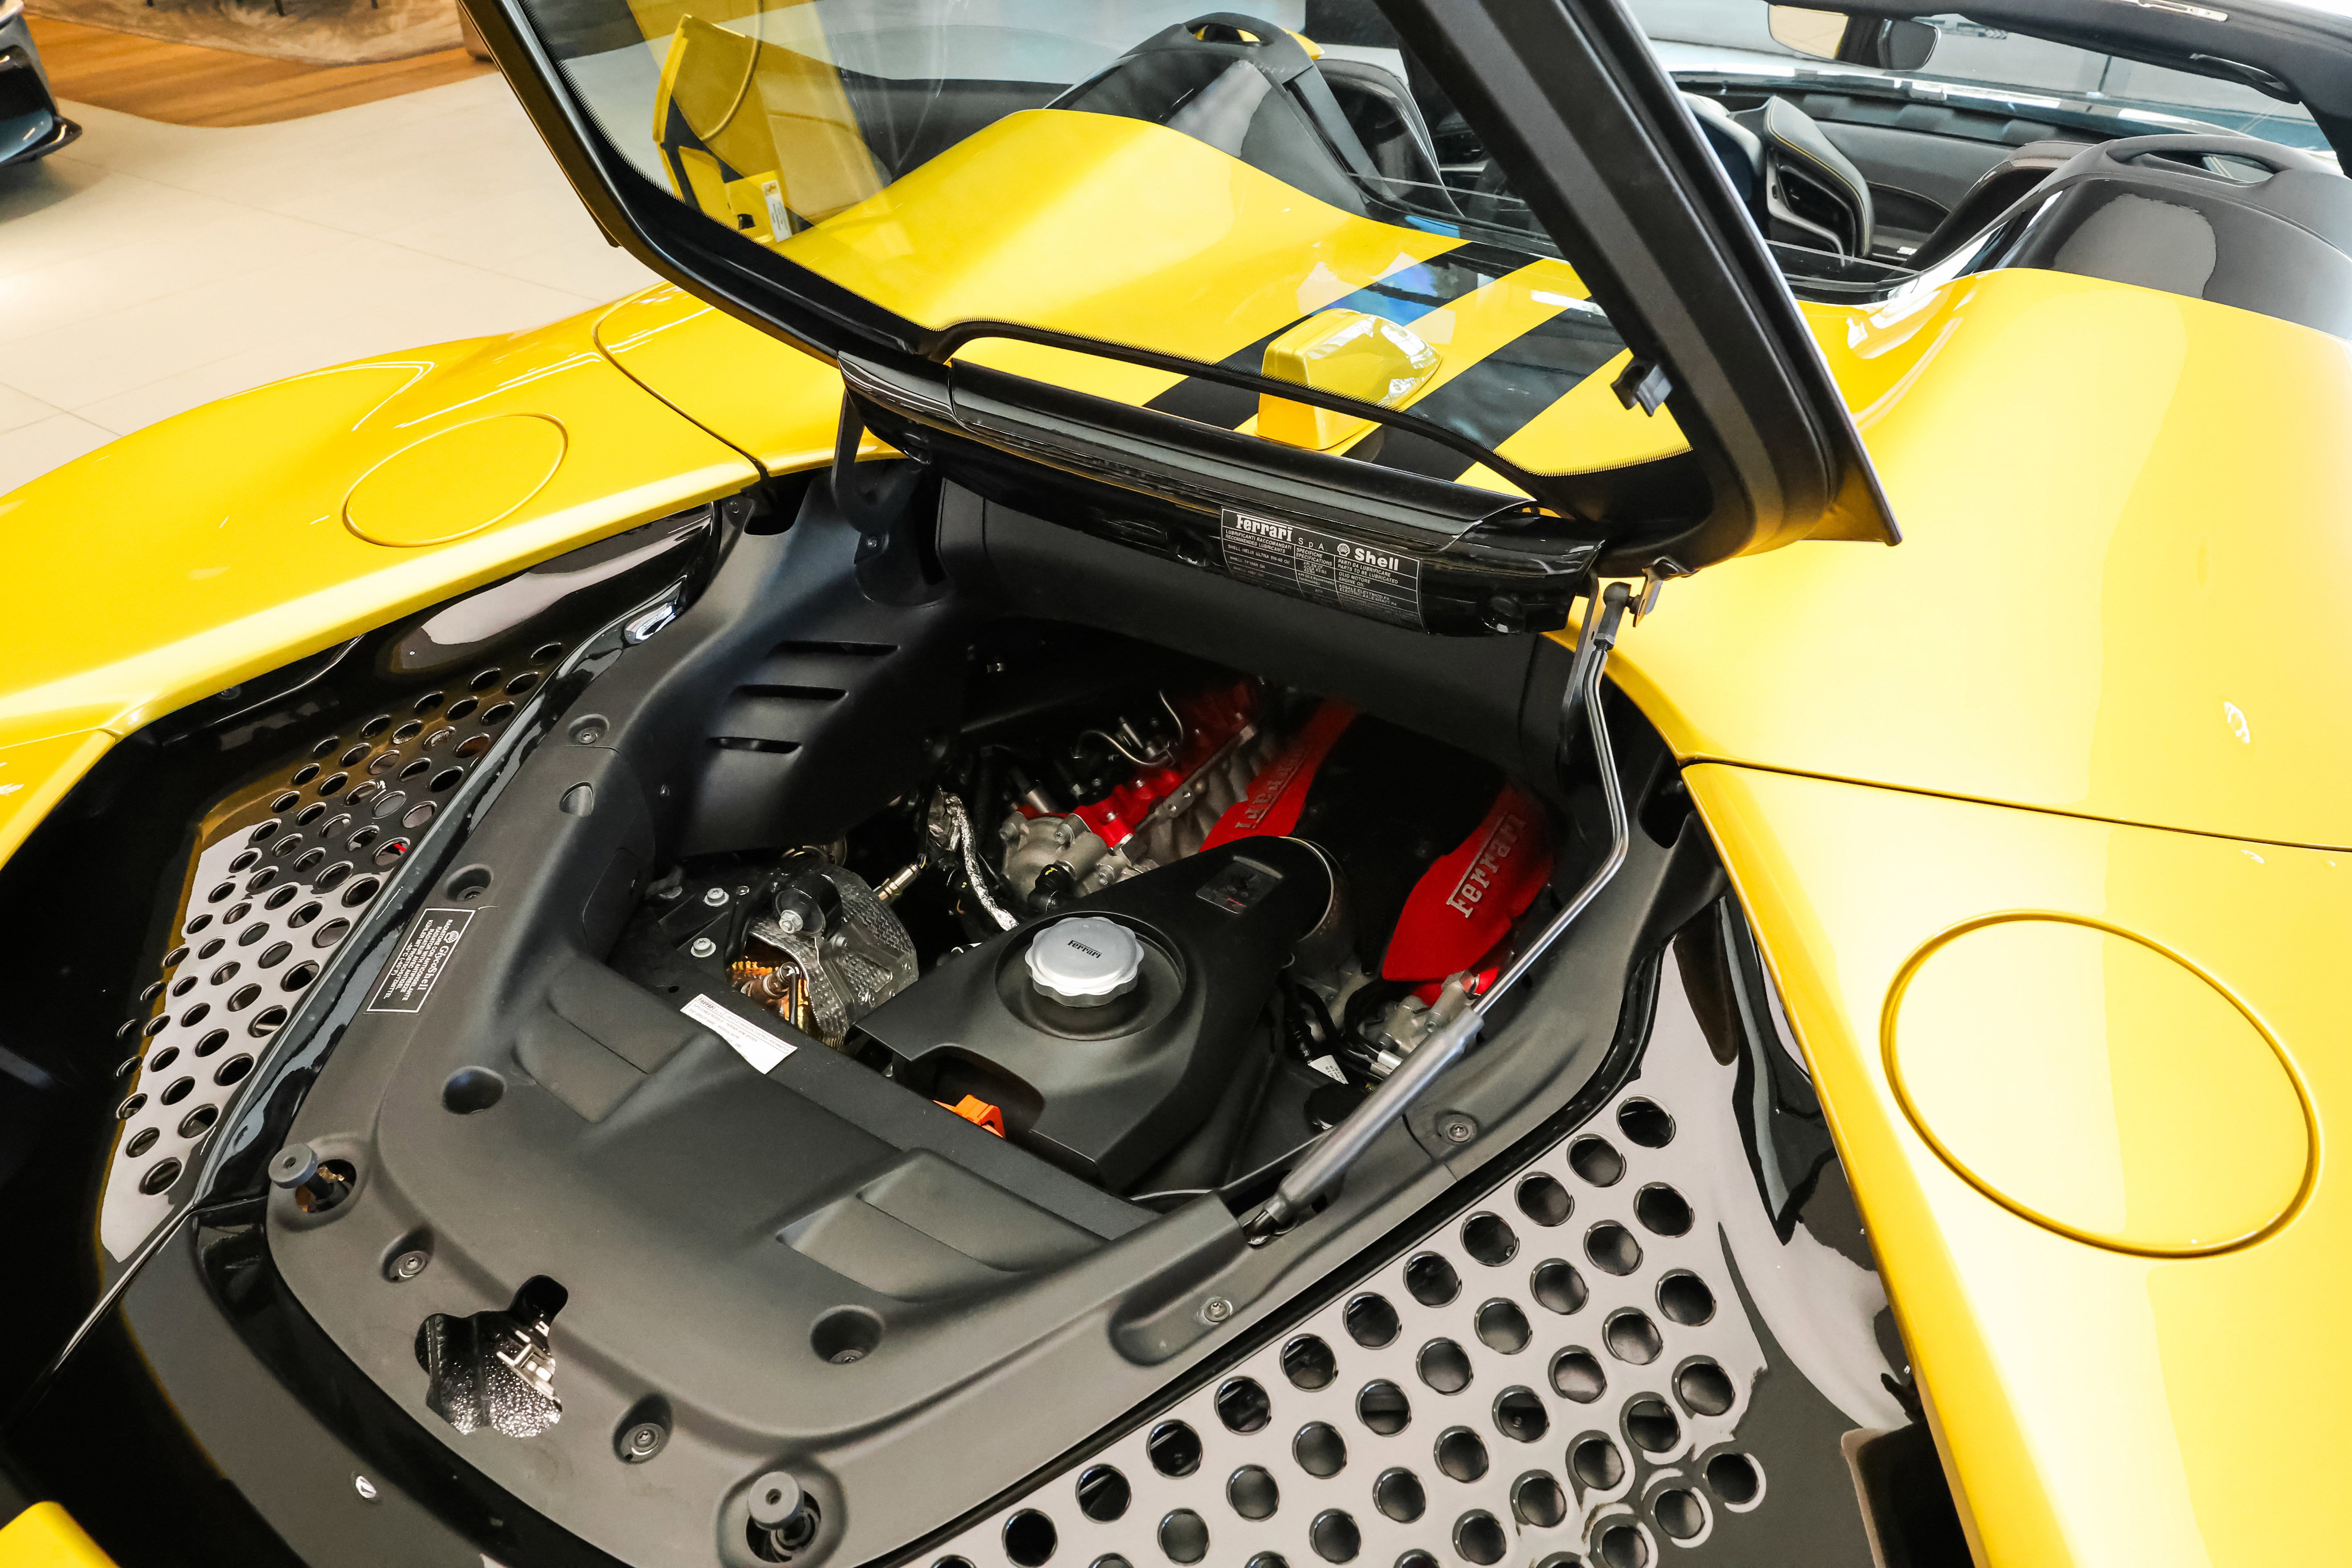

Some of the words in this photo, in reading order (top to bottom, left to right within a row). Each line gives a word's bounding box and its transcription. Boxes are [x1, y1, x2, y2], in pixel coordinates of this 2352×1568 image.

[1236, 514, 1293, 541] Ferrari
[1226, 529, 1255, 540] LUBRIFICANTI
[1257, 537, 1292, 549] RACCOMANDATI
[1226, 535, 1257, 546] RECOMMENDED
[1259, 543, 1285, 553] LUBRICANTS
[1296, 548, 1323, 558] SPECIFICHE
[1296, 553, 1332, 566] SPECIFICATIONS
[1354, 548, 1399, 571] Shell
[1351, 575, 1370, 584] MOTORE
[1360, 566, 1391, 577] LUBRIFICARE
[1369, 572, 1398, 584] LUBRICATED
[1357, 589, 1383, 598] ELETTRICO
[1446, 811, 1527, 918] Ferrari
[419, 920, 433, 938] KÜHLER
[425, 927, 442, 949] RADIATOR
[434, 920, 453, 945] RADIATORE
[416, 929, 434, 954] RADIATEUR
[1067, 940, 1102, 959] Ferrari
[417, 951, 428, 962] WITH
[428, 946, 437, 956] CON
[408, 956, 418, 968] AVEC
[417, 946, 448, 989] GlycoShell
[383, 948, 417, 999] FROSTSCHUTZMITTEL
[395, 969, 411, 989] ANTIGEL
[400, 963, 421, 992] ANTIFREEZE
[402, 958, 430, 1000] ANTICONGELANTE
[698, 998, 716, 1010] Ferrari
[739, 1022, 753, 1031] EMISSION
